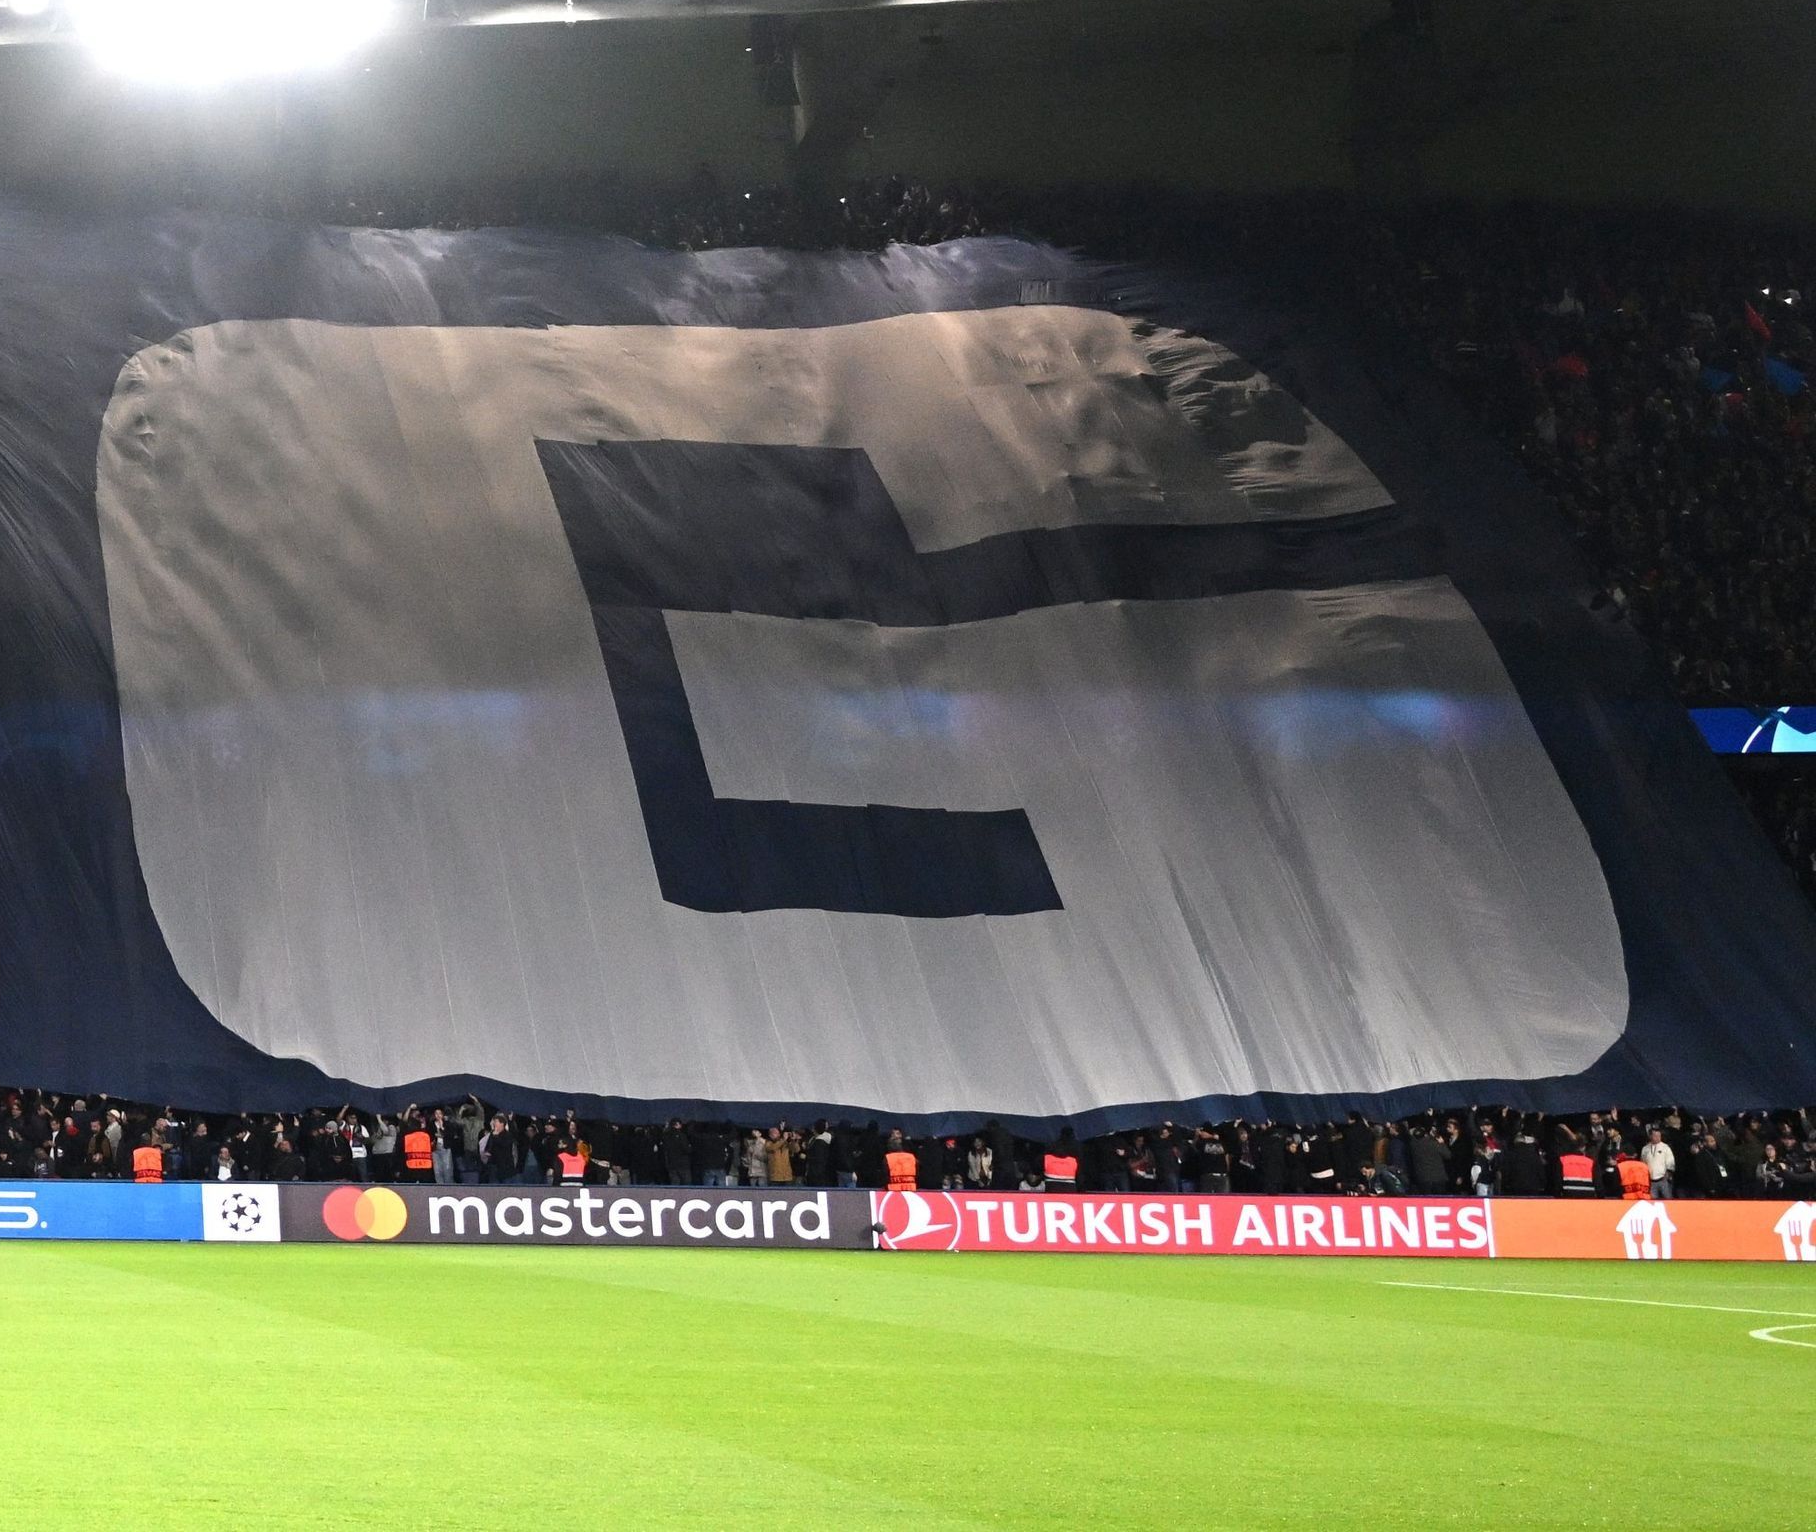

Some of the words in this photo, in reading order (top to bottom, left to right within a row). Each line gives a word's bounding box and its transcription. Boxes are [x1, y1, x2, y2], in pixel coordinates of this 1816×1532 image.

[428, 1188, 830, 1240] mastercard
[966, 1200, 1215, 1247] TURKISH
[1232, 1203, 1489, 1250] AIRLINES
